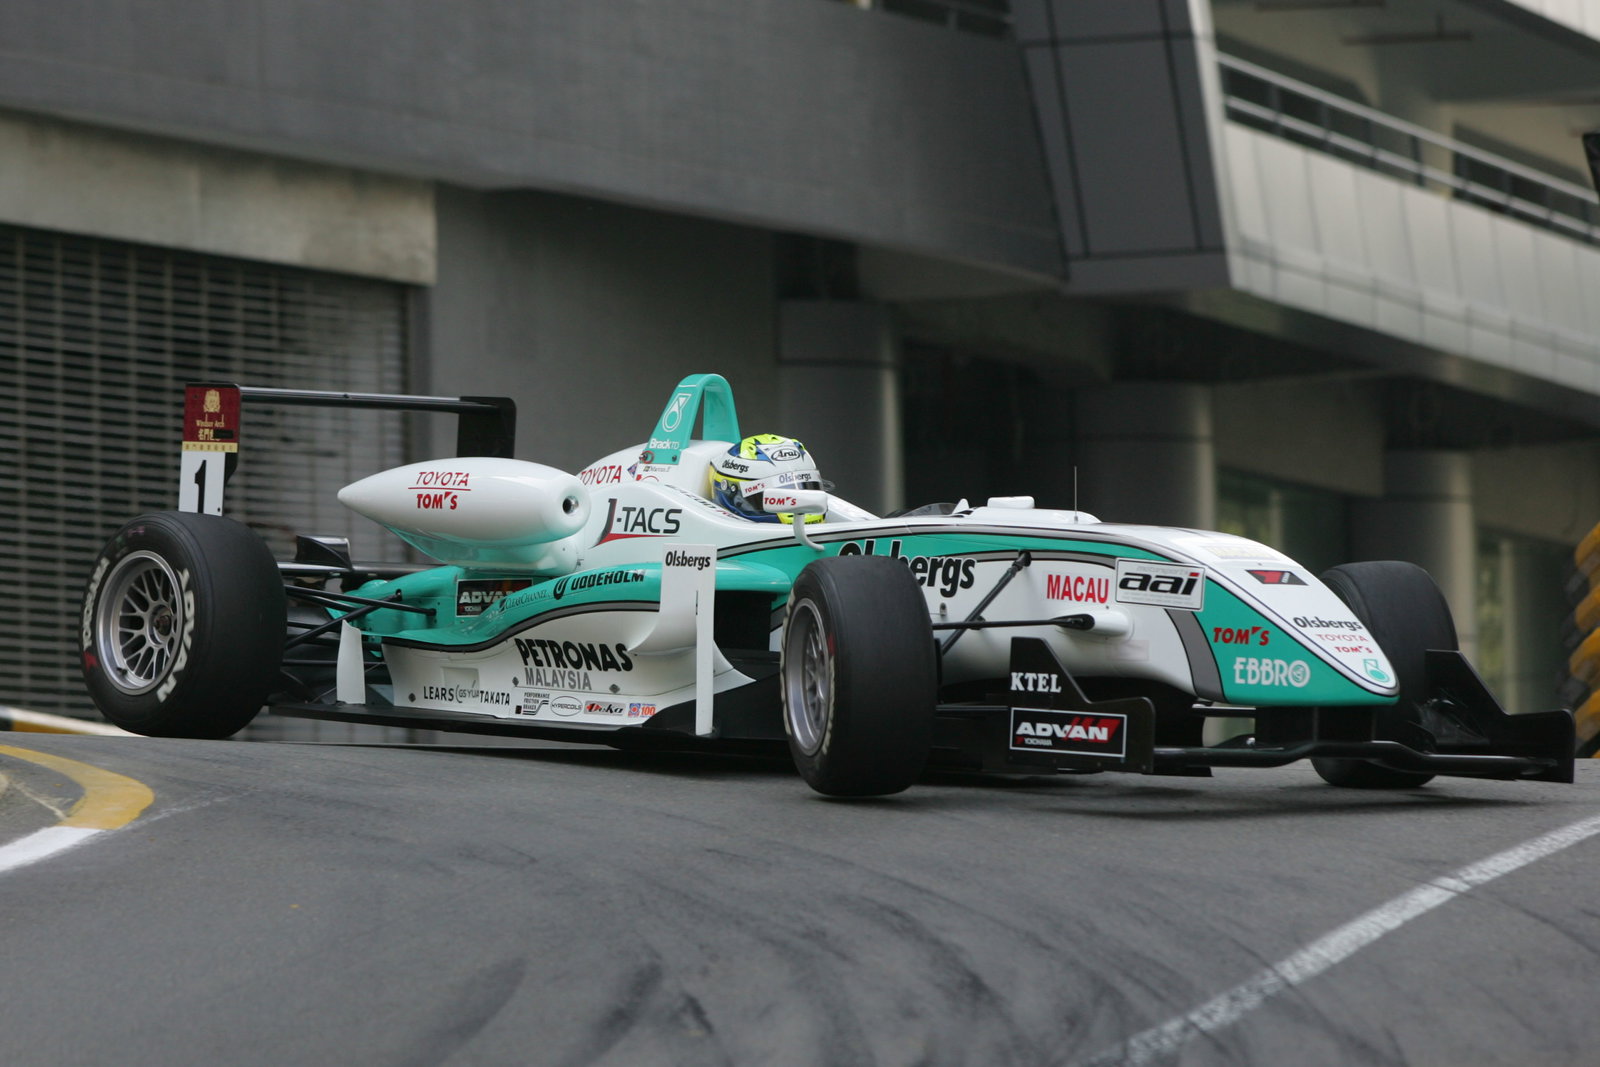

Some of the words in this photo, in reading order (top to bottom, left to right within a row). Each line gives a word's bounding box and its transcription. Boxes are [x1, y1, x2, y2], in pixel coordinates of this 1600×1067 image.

[777, 449, 798, 458] Arai
[580, 465, 622, 485] TOYOTA
[722, 460, 749, 473] Olsbergs
[194, 459, 207, 513] 1
[416, 471, 470, 487] TOYOTA
[779, 472, 812, 484] Olsbergs
[416, 491, 458, 510] TOM'S
[764, 497, 797, 505] TOM'S
[598, 498, 682, 544] J-TACS
[665, 550, 711, 571] Olsbergs
[1046, 574, 1109, 604] MACAU
[1119, 572, 1200, 596] aai
[1293, 617, 1363, 632] Olsbergs
[1213, 626, 1270, 646] TOM'S
[1317, 633, 1369, 643] TOYOTA
[514, 638, 633, 672] PETRONAS
[1334, 646, 1373, 654] TOM'S
[525, 667, 592, 691] MALAYSIA
[1234, 657, 1311, 688] EBBRO
[1010, 672, 1062, 693] KTEL
[423, 686, 455, 701] LEARS
[480, 691, 511, 706] TAKATA
[641, 706, 656, 716] 100
[1015, 721, 1109, 741] ADVAN
